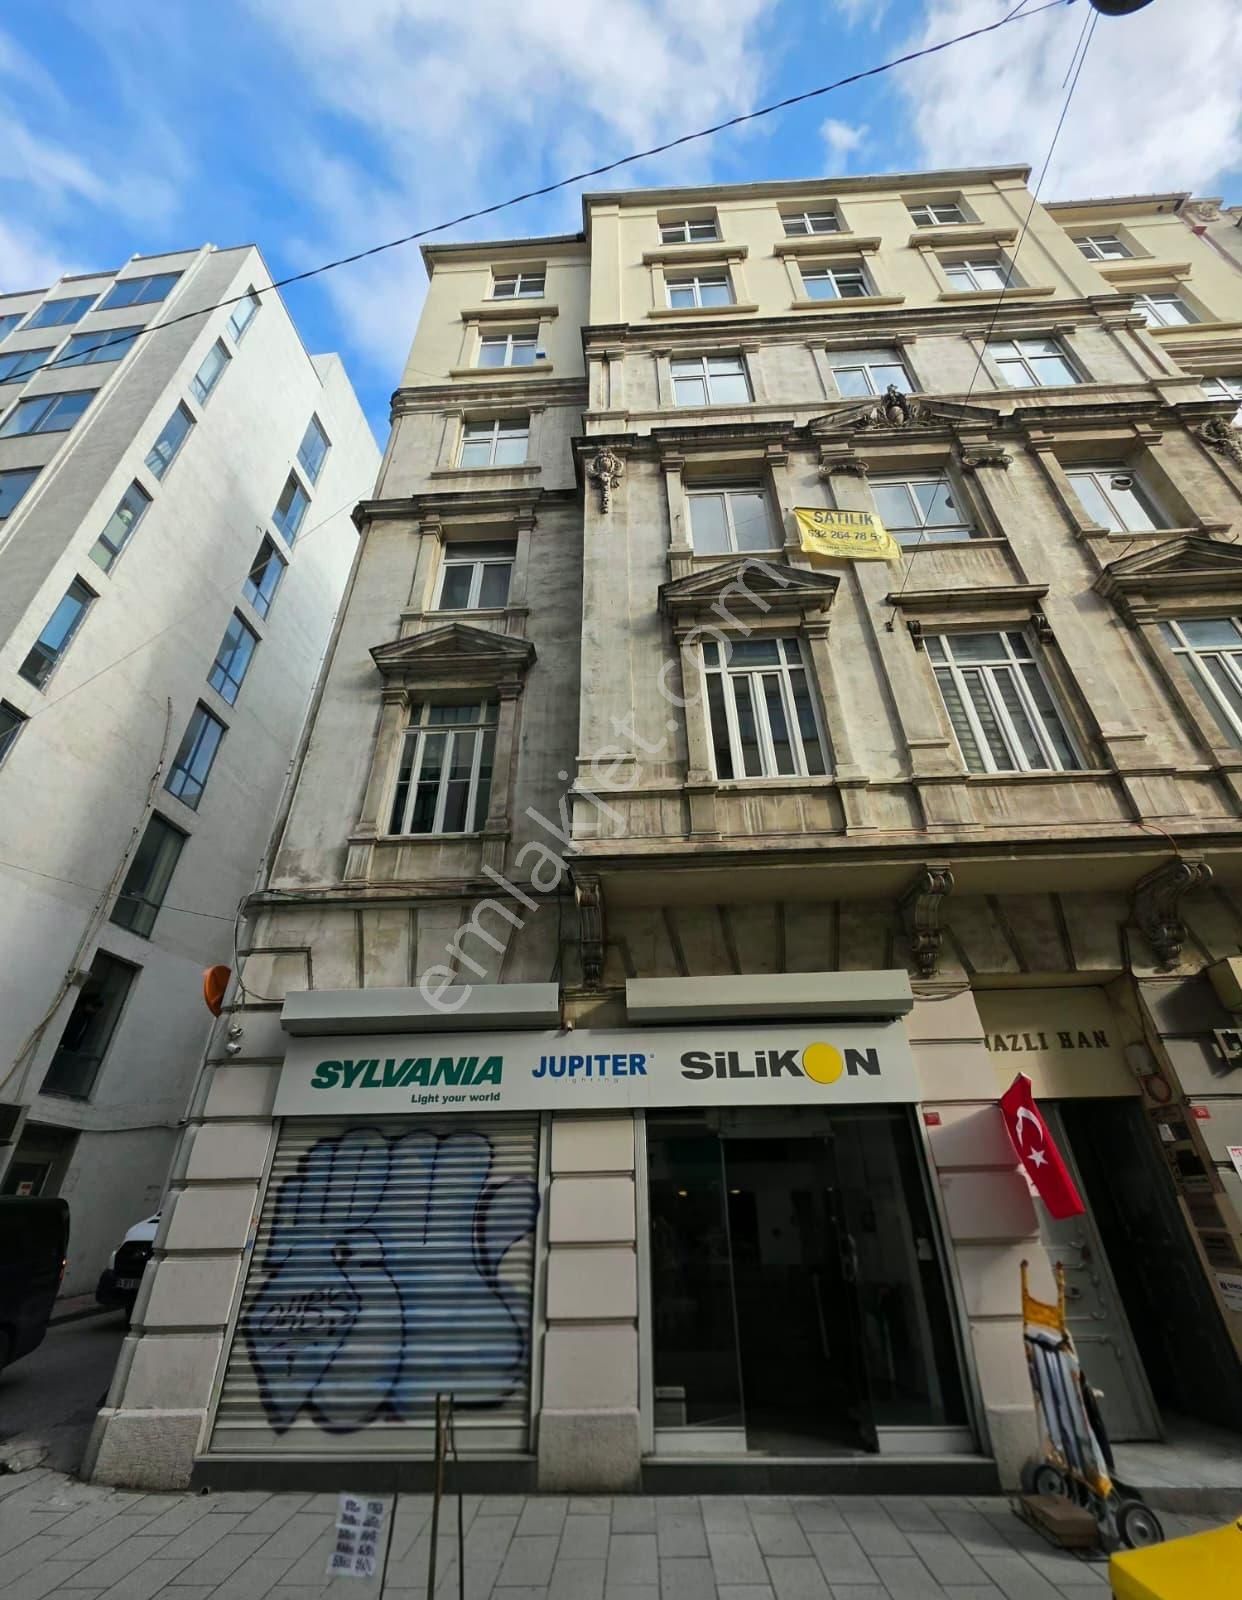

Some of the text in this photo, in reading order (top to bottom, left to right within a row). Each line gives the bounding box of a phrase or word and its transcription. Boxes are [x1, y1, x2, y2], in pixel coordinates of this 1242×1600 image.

[813, 511, 873, 525] SATILIK
[854, 531, 867, 541] 78
[1057, 1030, 1111, 1049] HAN
[310, 1056, 504, 1090] SYLVANIA
[531, 1053, 648, 1079] JUPITER
[411, 1091, 501, 1105] Light your world
